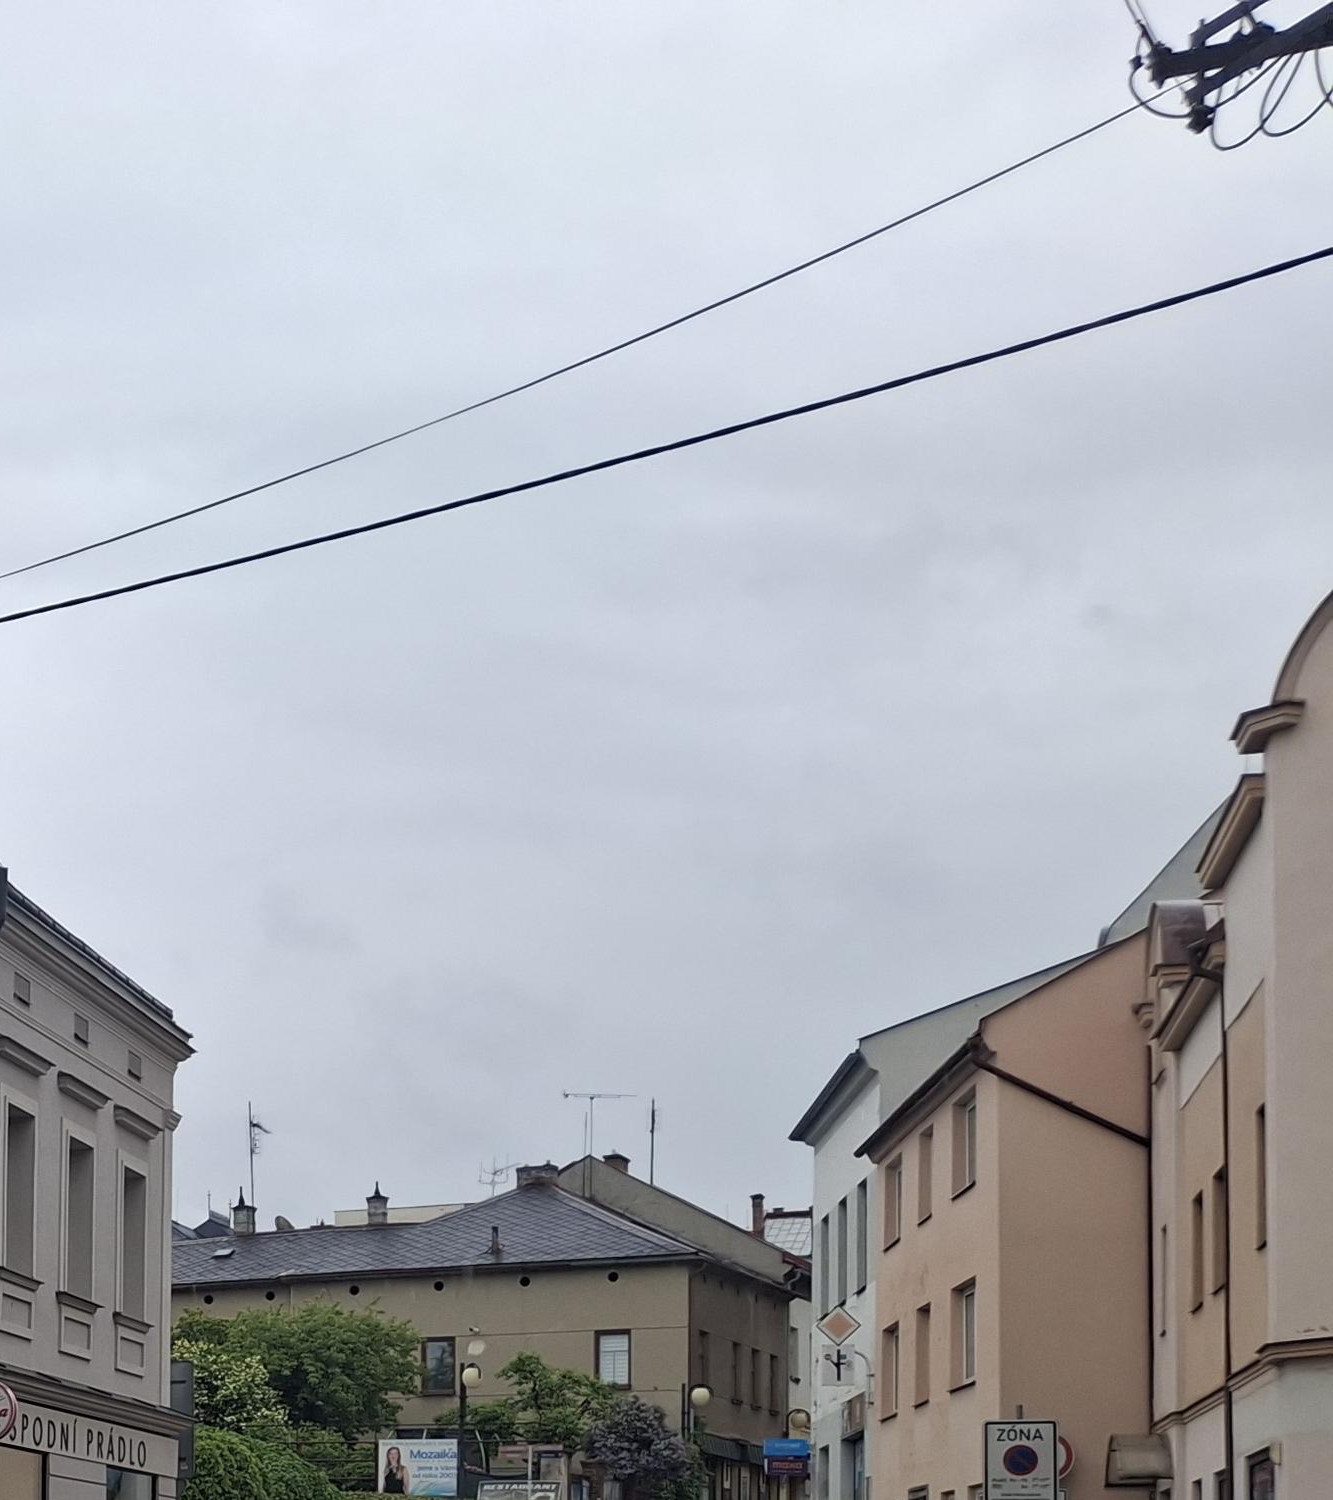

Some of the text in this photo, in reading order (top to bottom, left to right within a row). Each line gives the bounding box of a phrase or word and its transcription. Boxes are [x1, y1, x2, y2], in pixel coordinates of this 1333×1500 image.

[996, 1425, 1044, 1442] ZÓNA
[87, 1426, 147, 1468] PRÁDLO
[483, 1483, 557, 1491] RESTAUANT
